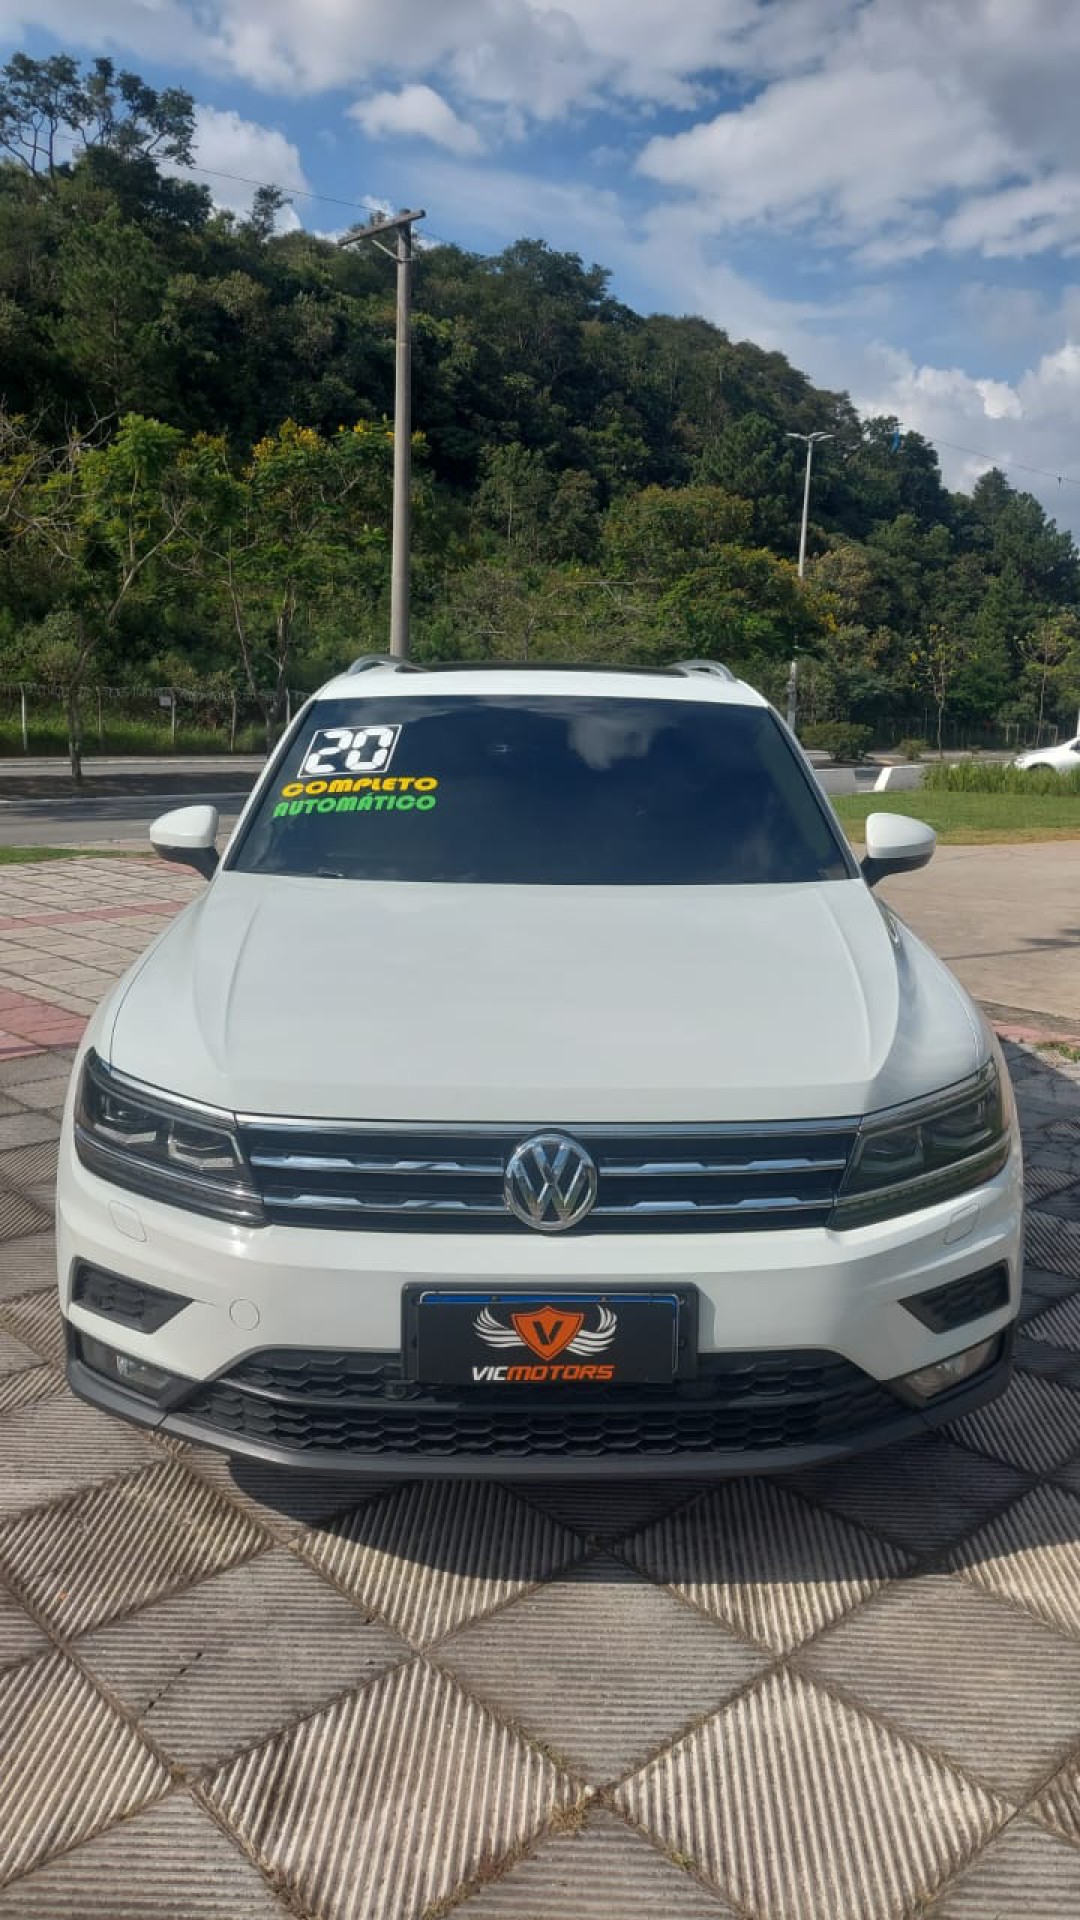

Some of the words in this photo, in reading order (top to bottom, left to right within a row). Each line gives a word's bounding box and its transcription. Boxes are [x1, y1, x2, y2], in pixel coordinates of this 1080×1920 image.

[305, 727, 394, 774] 20
[281, 776, 439, 798] COMPLETO
[272, 793, 437, 817] AUTOMÁTICO
[532, 1320, 564, 1346] V
